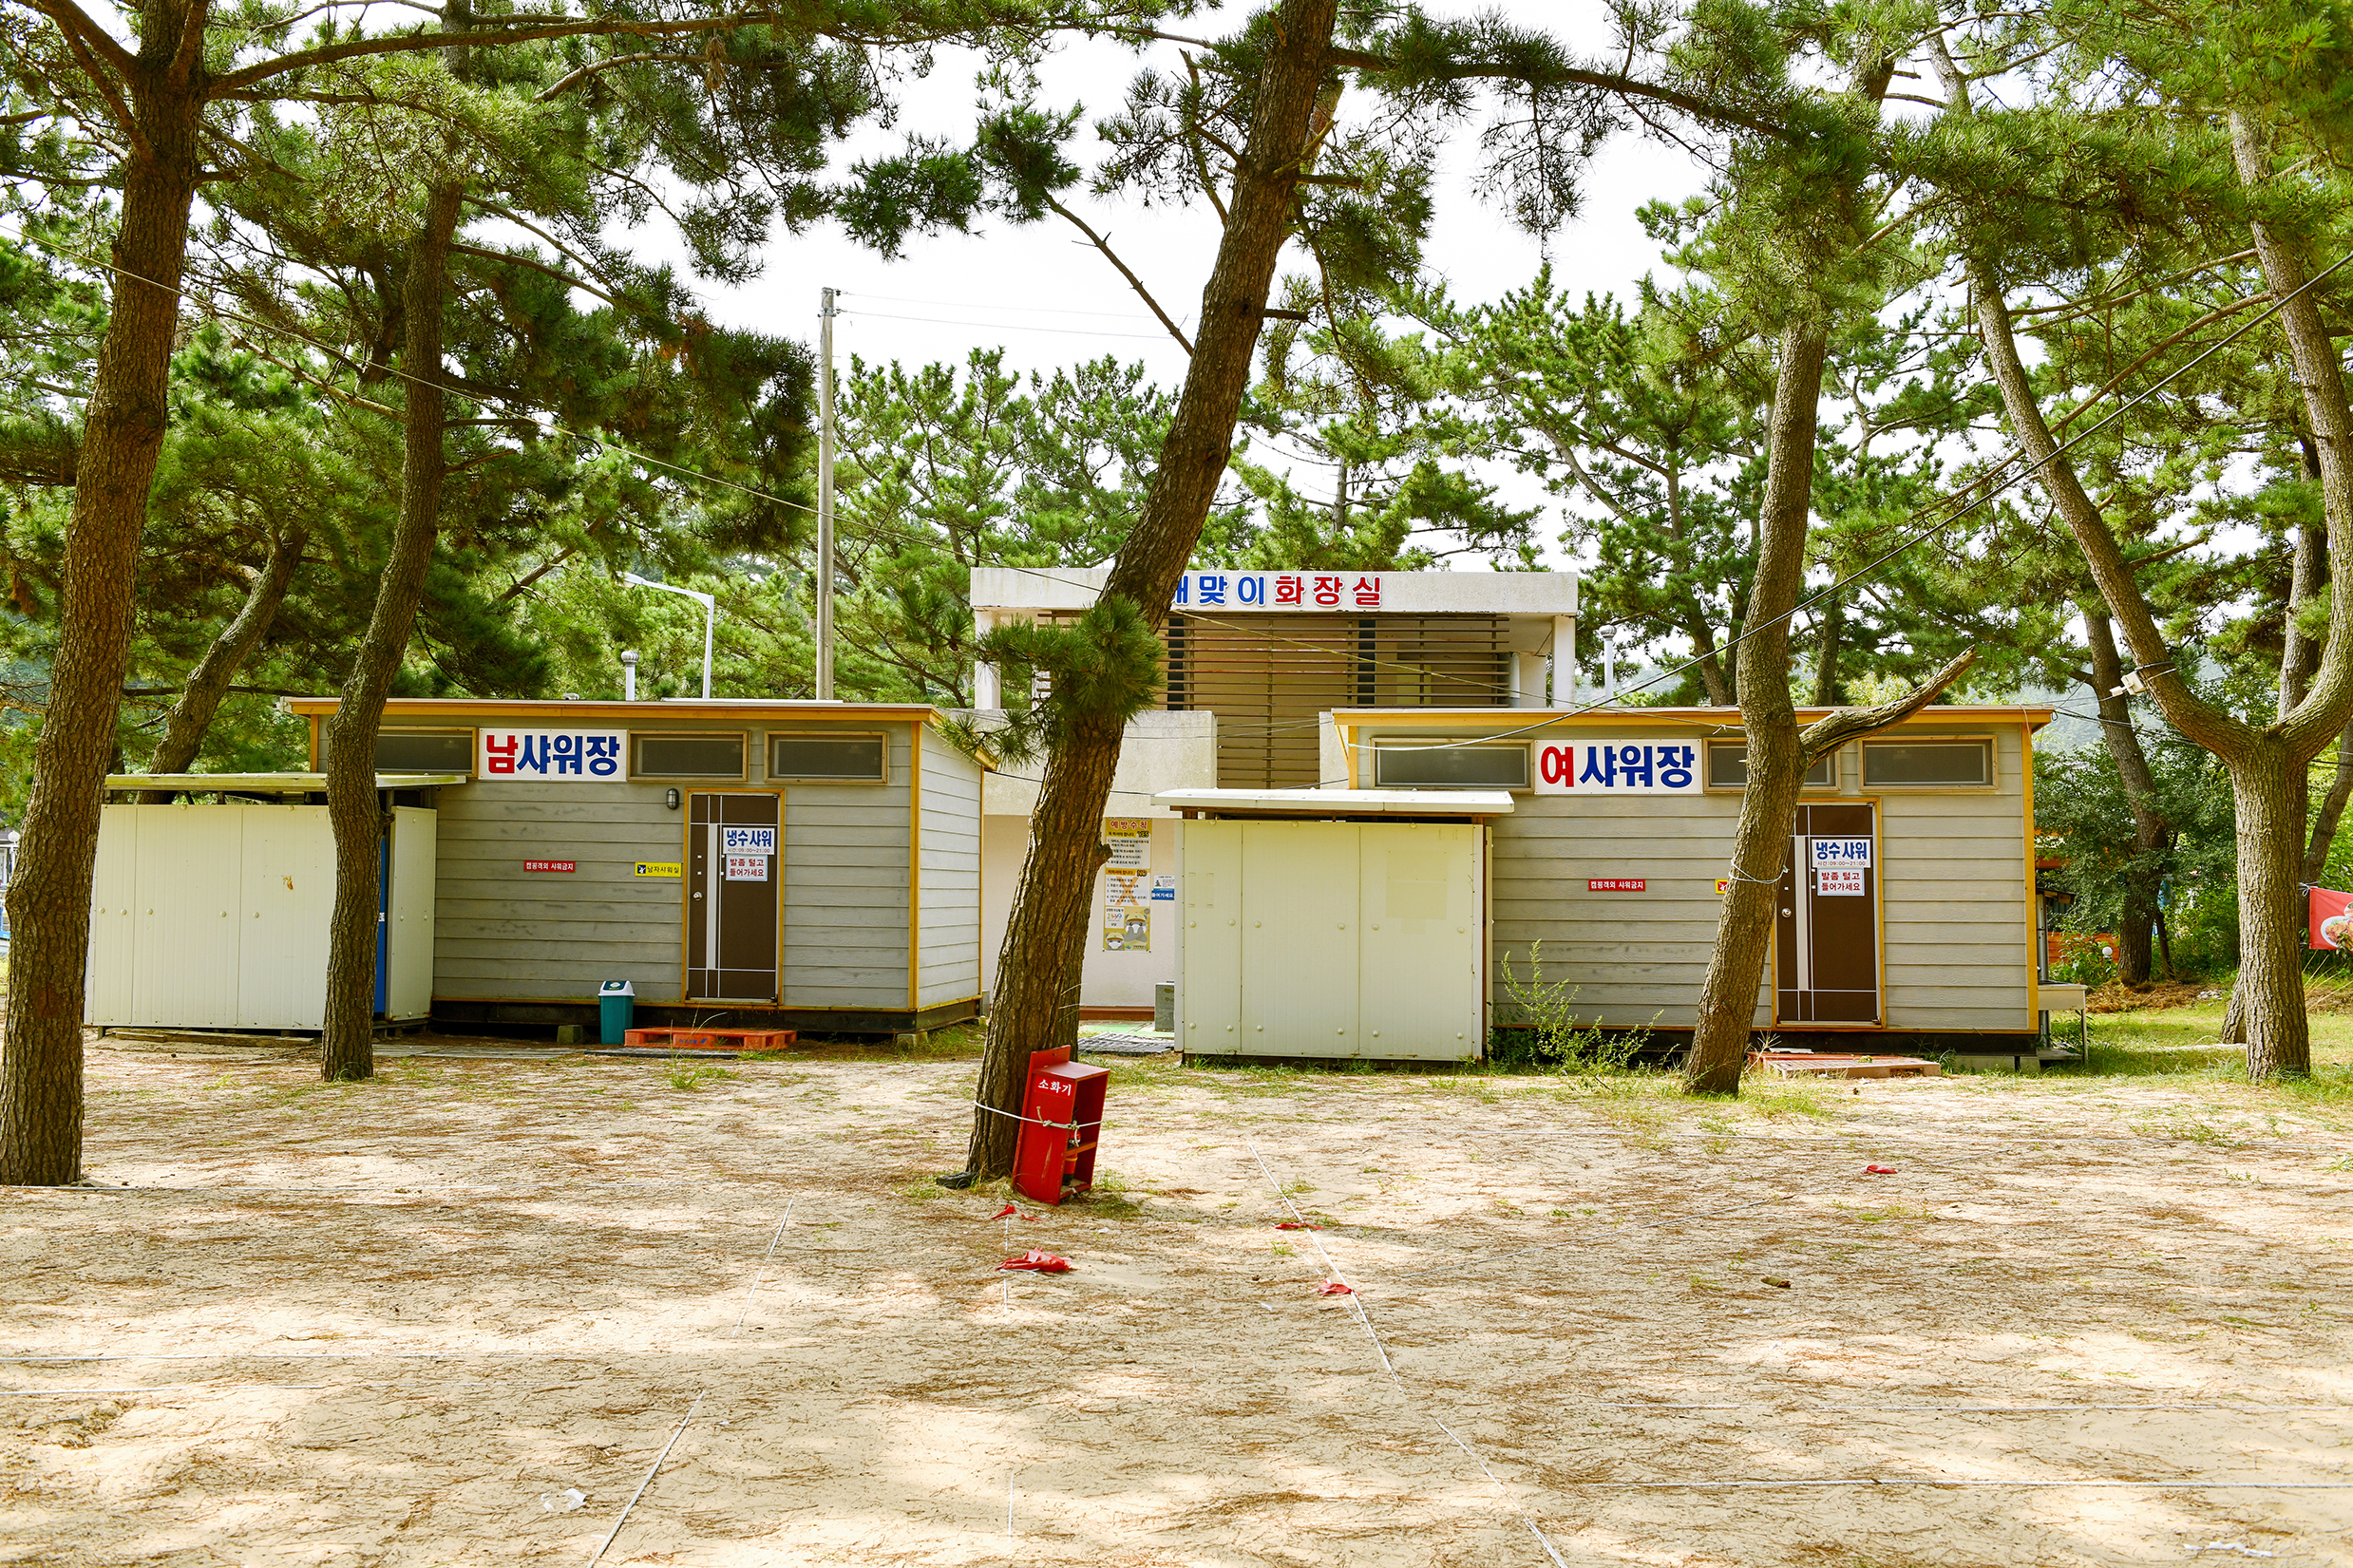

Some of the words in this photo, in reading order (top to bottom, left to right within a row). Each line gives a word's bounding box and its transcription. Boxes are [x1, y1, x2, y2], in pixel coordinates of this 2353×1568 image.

[485, 734, 620, 776] 남샤워장
[1540, 745, 1696, 788] 여샤워장
[730, 868, 765, 877] 들어가세요
[1821, 882, 1861, 892] 들어가세요
[1037, 1079, 1072, 1097] 소화기
